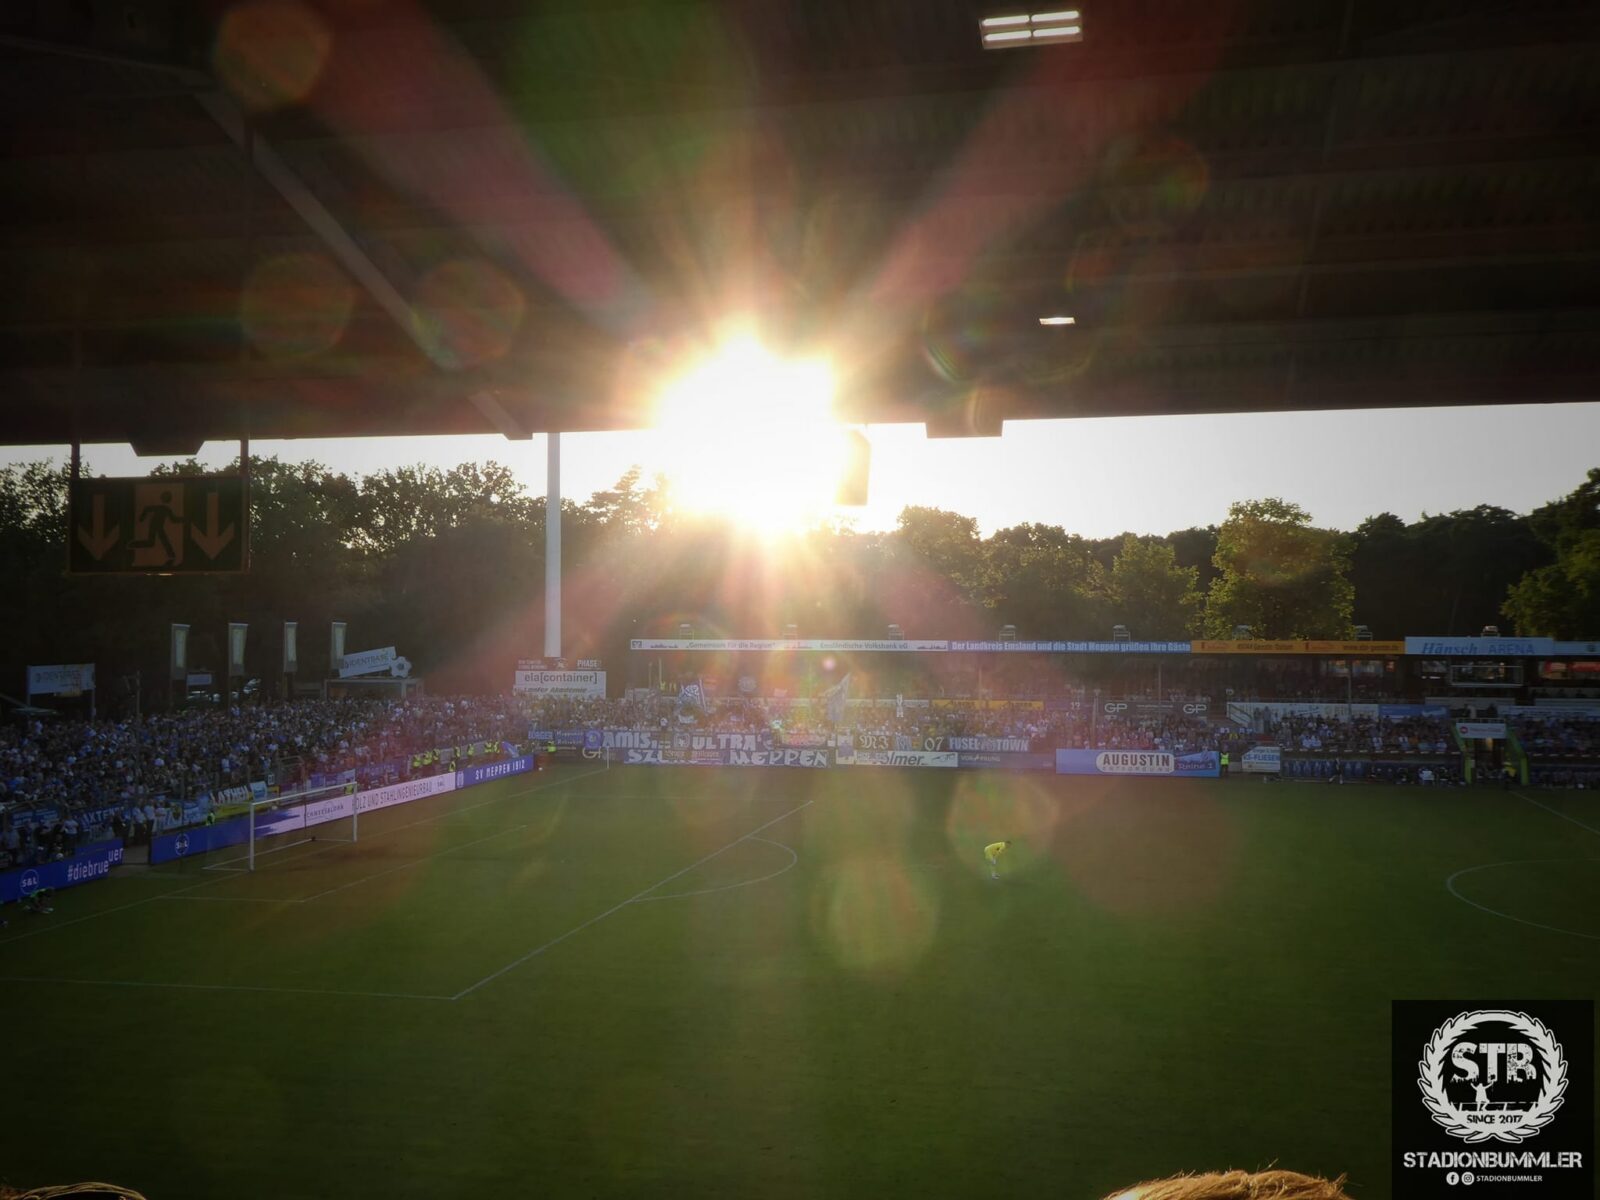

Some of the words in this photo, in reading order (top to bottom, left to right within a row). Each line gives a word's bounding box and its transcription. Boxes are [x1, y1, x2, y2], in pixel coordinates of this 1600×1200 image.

[865, 640, 897, 649] Volksbank
[952, 641, 965, 651] Der
[966, 641, 1004, 651] Landkreis
[1004, 641, 1036, 651] Emsland
[1037, 641, 1052, 651] und
[1053, 641, 1066, 651] die
[1067, 641, 1087, 651] Stadt
[1088, 642, 1120, 653] Meppen
[1121, 642, 1149, 653] grüßen
[1168, 642, 1191, 652] Gäste
[1422, 641, 1478, 655] Hänsch
[1488, 644, 1535, 654] ARENA
[525, 672, 598, 685] ela[container]
[1104, 702, 1128, 713] GP
[1183, 703, 1207, 714] GP
[949, 736, 979, 750] FUSEL
[995, 738, 1030, 752] TOWN
[729, 750, 827, 768] MEPPEN
[1102, 753, 1170, 767] AUGUSTIN
[475, 767, 484, 781] SV
[486, 762, 511, 779] MEPPEN
[512, 759, 526, 773] 1912
[21, 876, 38, 889] S&L
